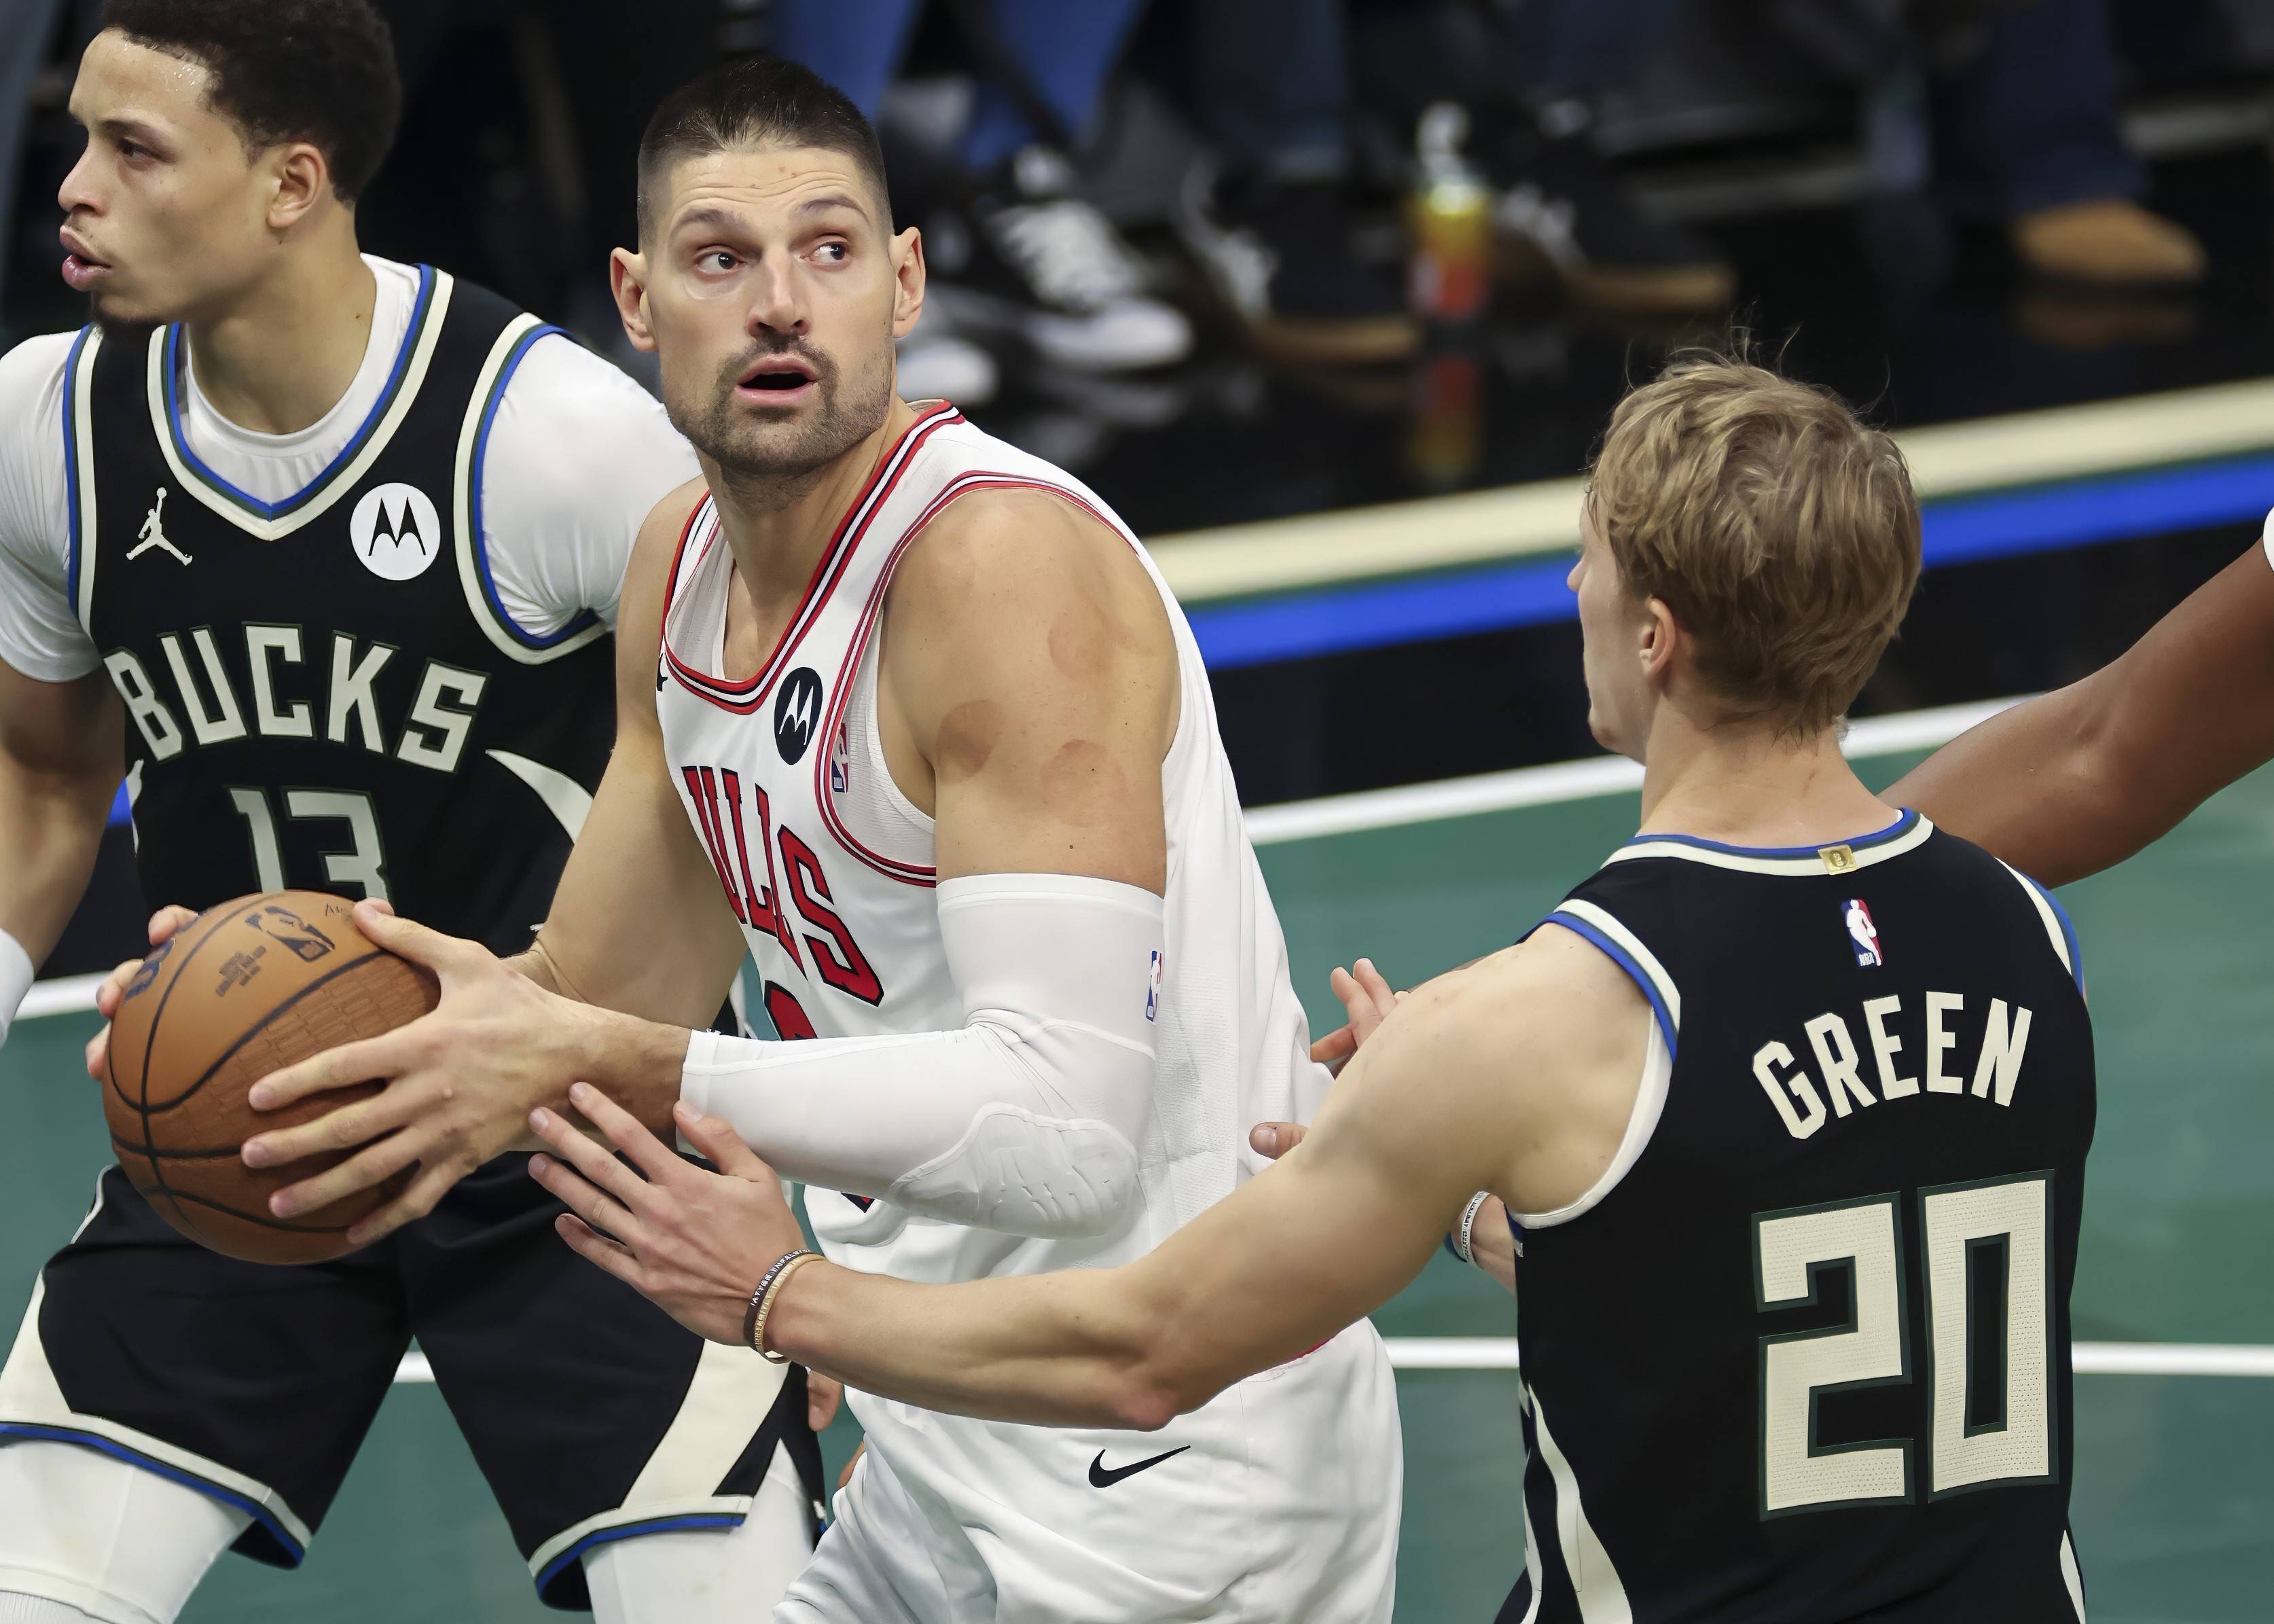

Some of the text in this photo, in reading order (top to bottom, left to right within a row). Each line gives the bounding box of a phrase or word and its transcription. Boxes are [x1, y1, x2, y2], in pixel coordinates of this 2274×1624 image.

[103, 622, 490, 773] BUCKS
[228, 787, 392, 901] 13
[681, 765, 884, 1007] ULLS
[1752, 991, 2033, 1140] GREEN
[1752, 1170, 2059, 1520] 20
